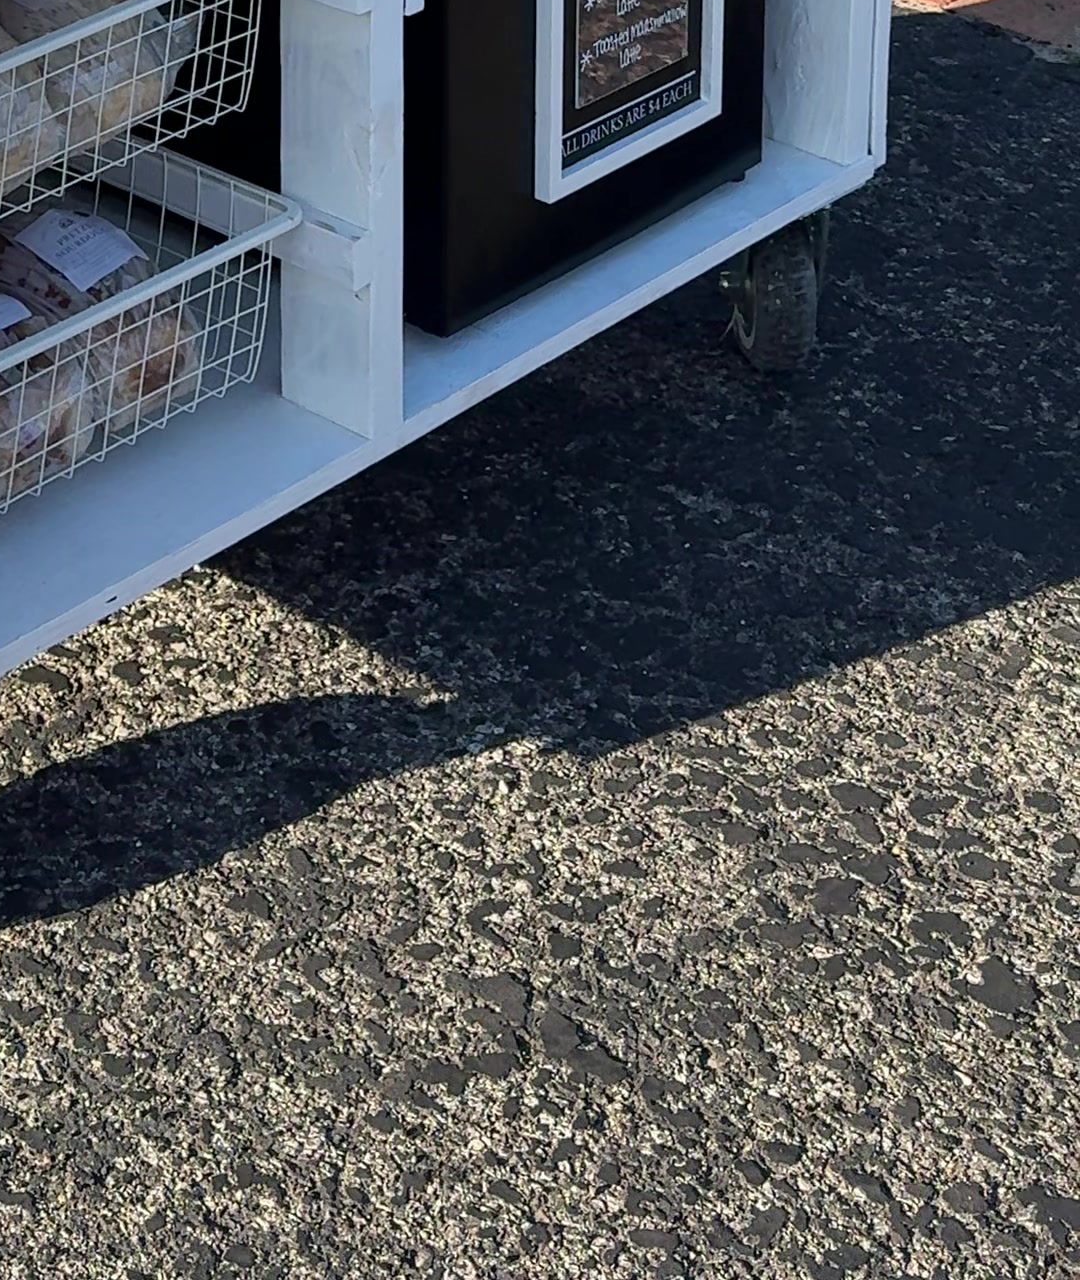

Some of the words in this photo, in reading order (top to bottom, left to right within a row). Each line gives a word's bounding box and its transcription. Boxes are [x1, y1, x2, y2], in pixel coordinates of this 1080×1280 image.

[580, 116, 625, 149] DRINKS
[624, 103, 648, 129] ARE
[648, 96, 662, 116] $4
[661, 79, 694, 112] EACH
